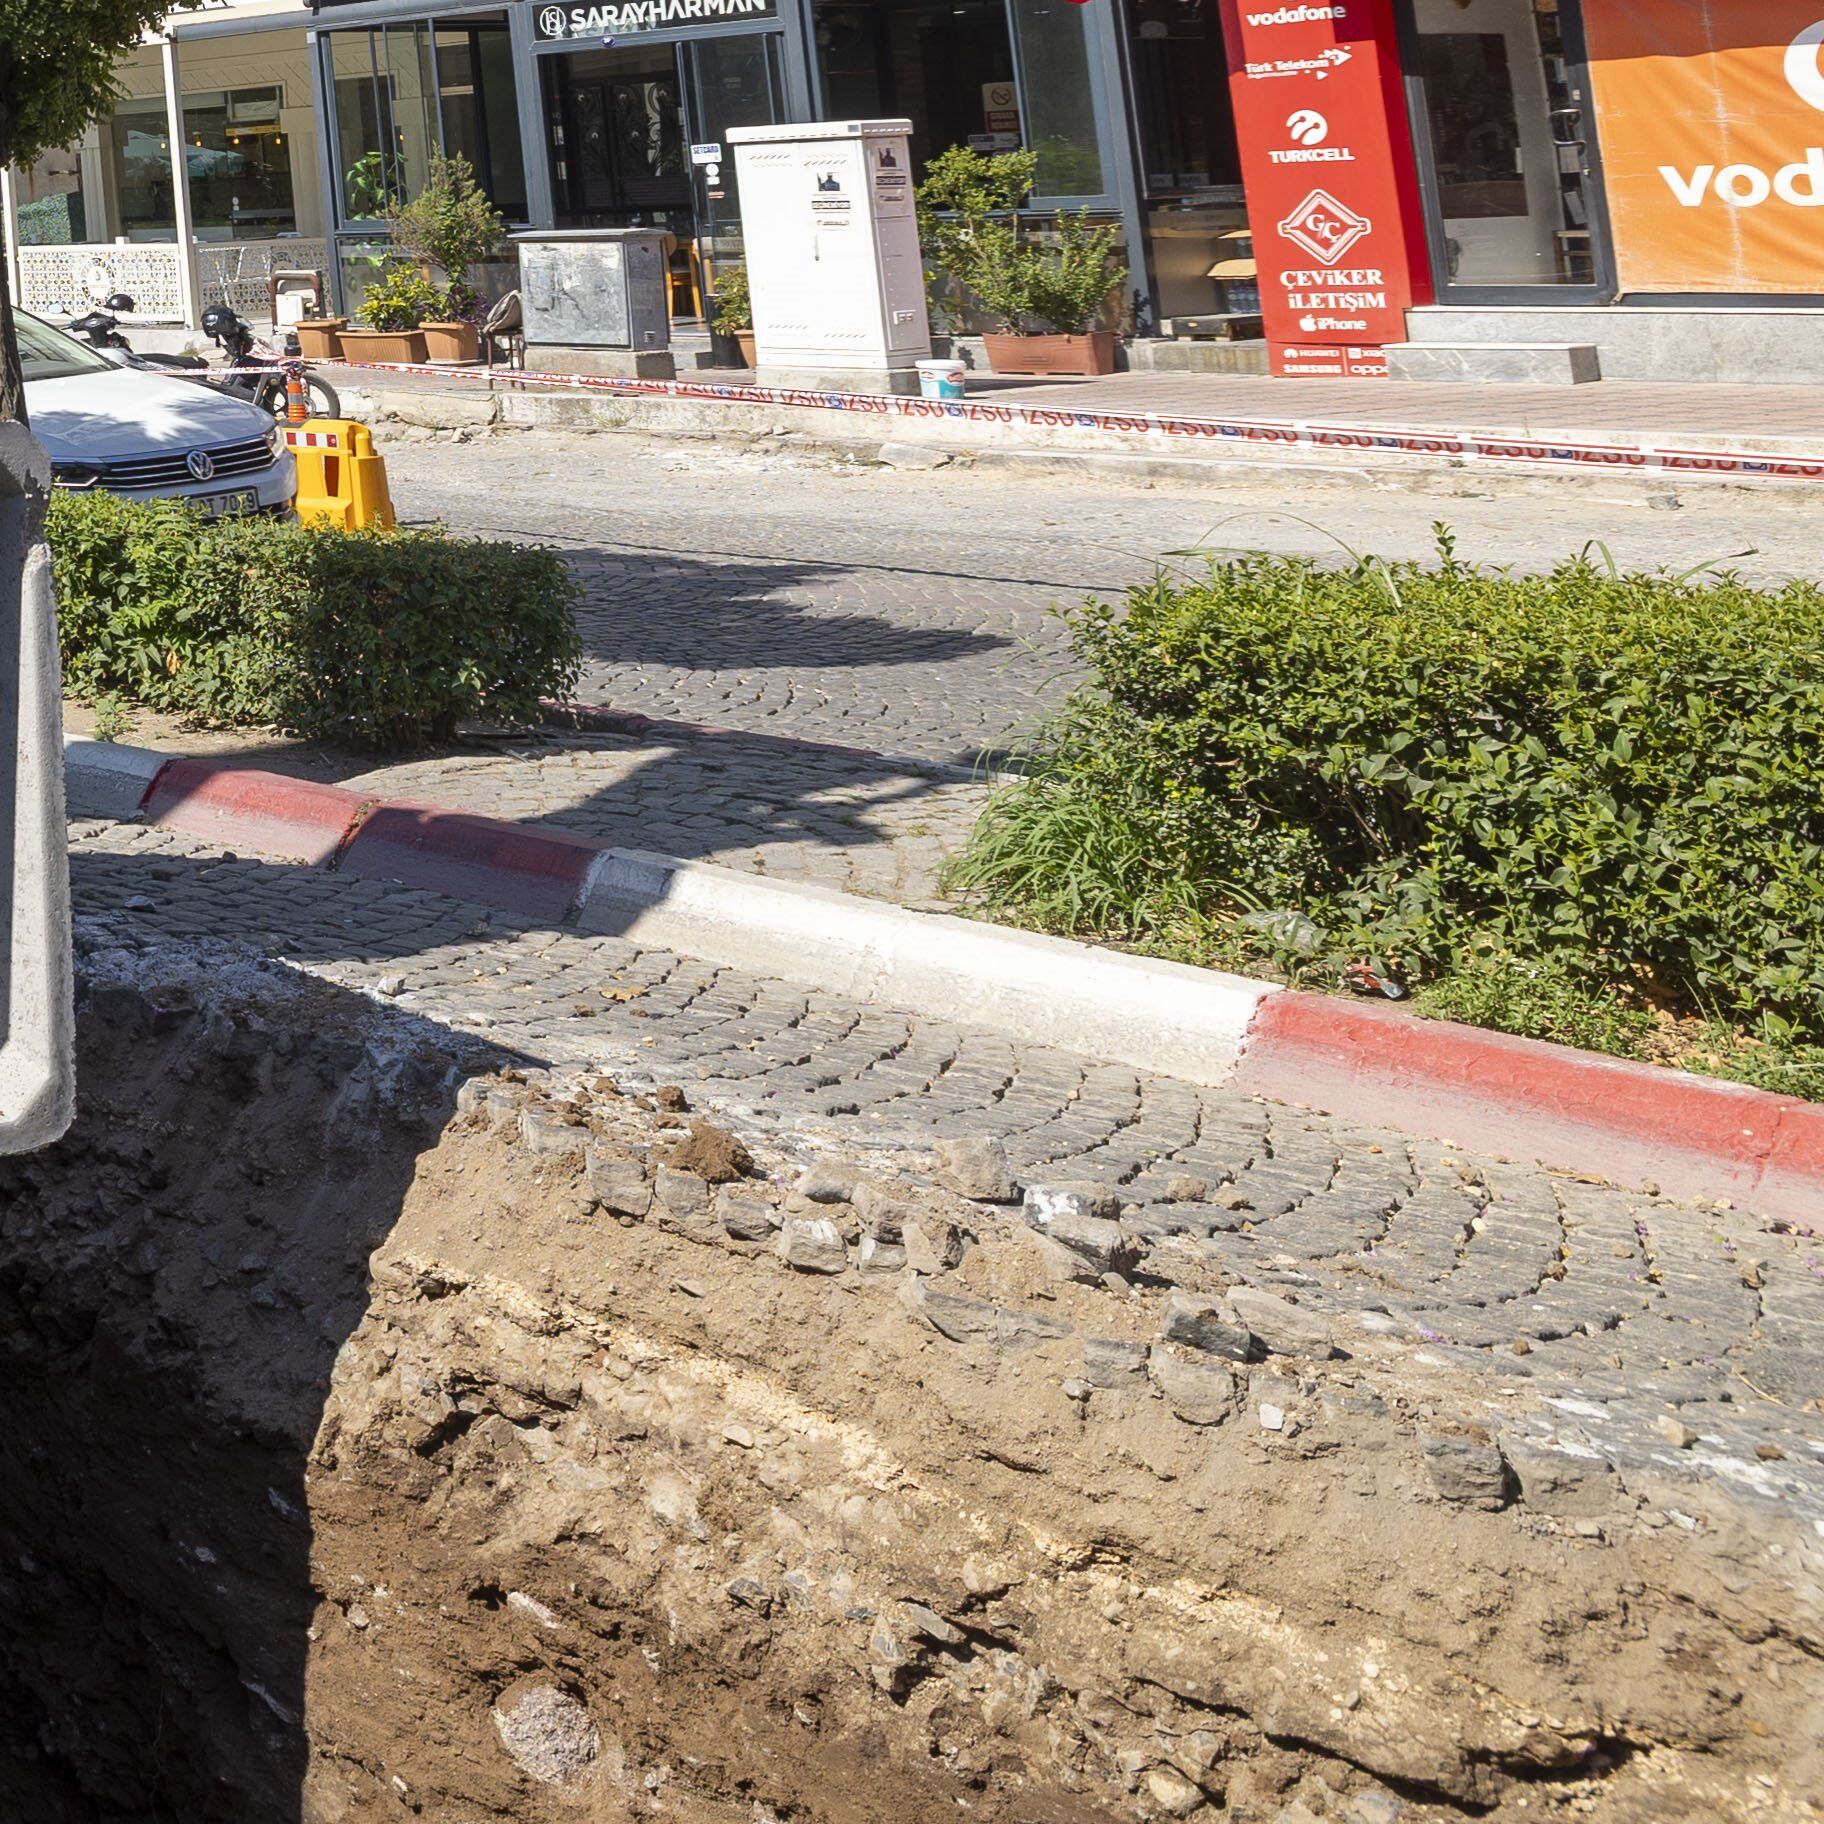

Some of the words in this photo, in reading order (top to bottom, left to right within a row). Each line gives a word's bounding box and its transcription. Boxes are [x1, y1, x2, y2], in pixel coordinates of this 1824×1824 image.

[1247, 5, 1346, 26] vodafone
[1245, 62, 1273, 74] Türk
[1274, 58, 1329, 71] Telekom
[1268, 148, 1355, 163] TURKCELL
[1317, 317, 1367, 330] iPhone
[1283, 364, 1341, 373] SAMSUNG
